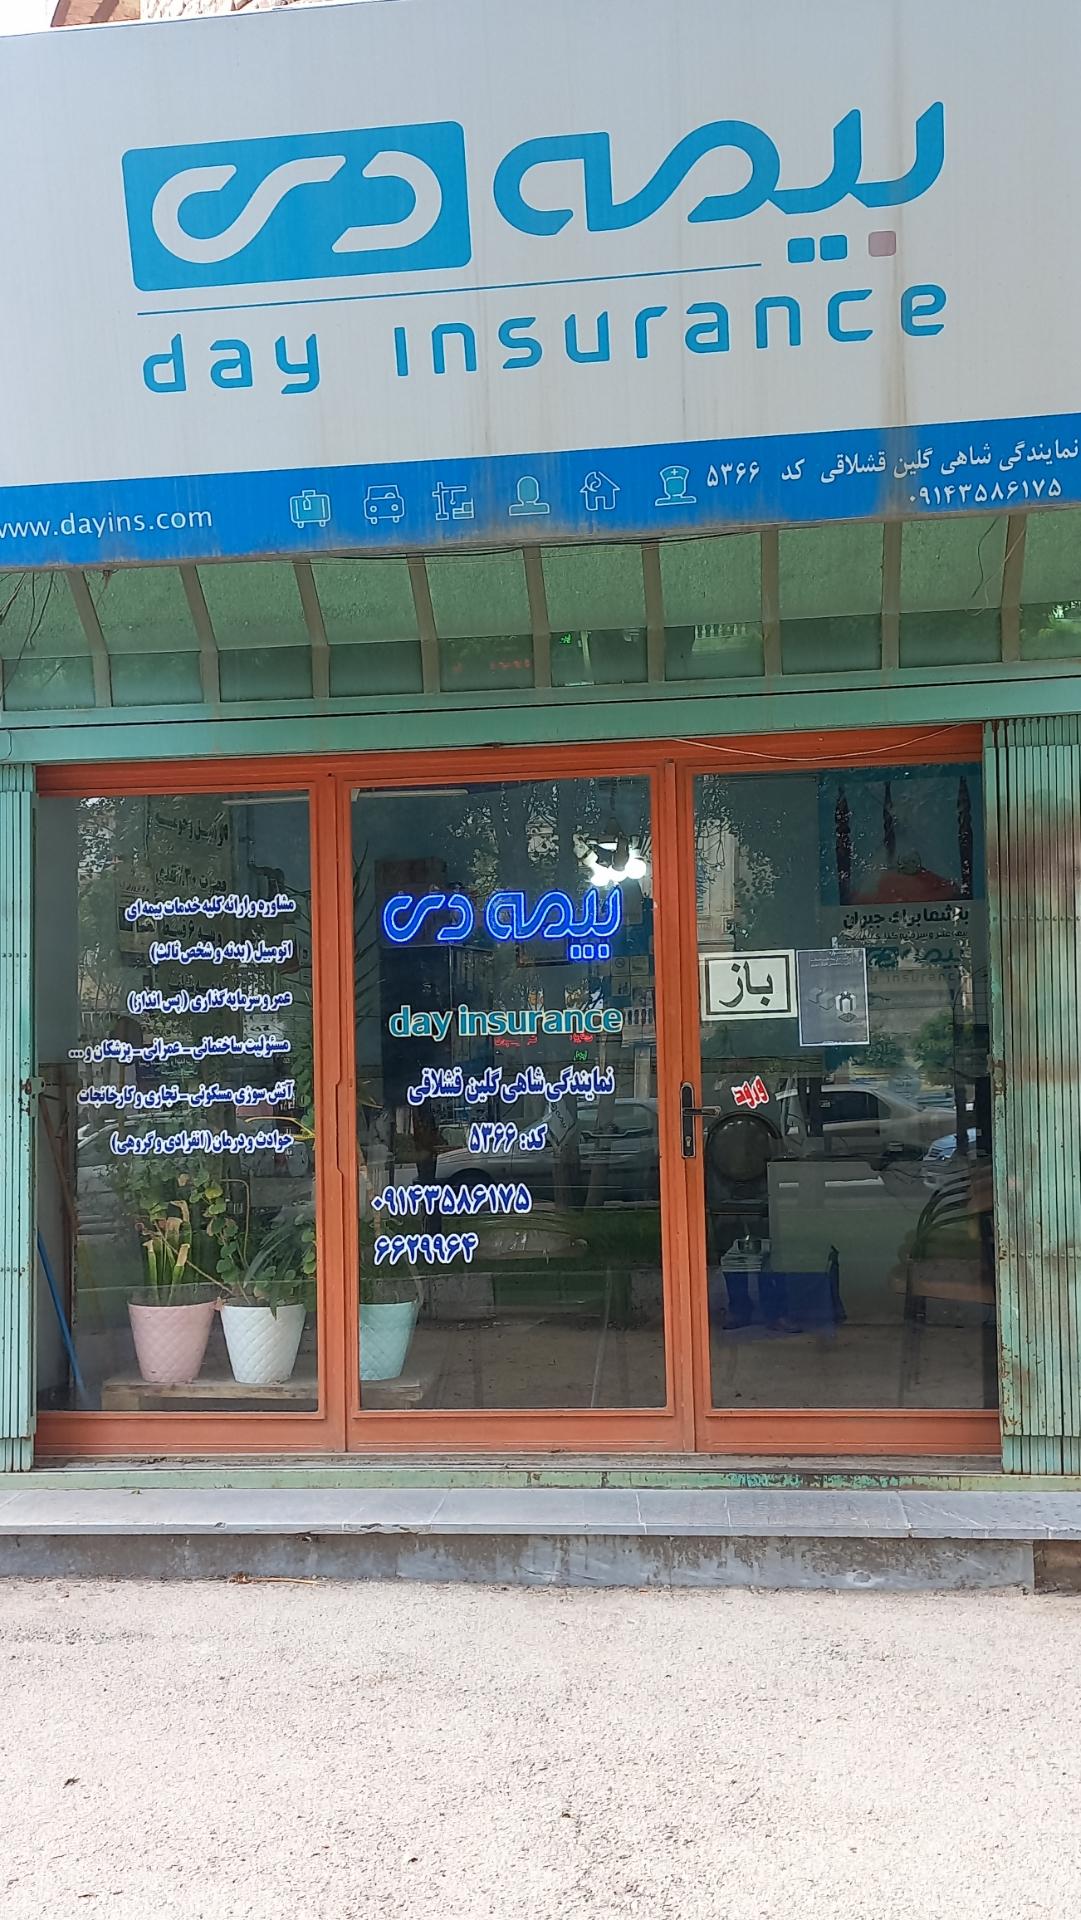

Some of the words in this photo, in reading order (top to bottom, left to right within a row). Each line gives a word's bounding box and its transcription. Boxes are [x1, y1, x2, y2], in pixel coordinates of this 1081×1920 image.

[493, 101, 945, 264] بیمه
[146, 144, 449, 269] دی
[143, 332, 321, 395] day
[394, 284, 947, 376] insurance
[820, 450, 886, 484] قشلاقی
[893, 447, 934, 479] گلین
[940, 443, 992, 476] شاهی
[999, 439, 1080, 471] نمایندگی
[707, 461, 760, 487] ۵۳۶۶
[781, 458, 806, 481] کد
[909, 477, 1062, 505] ۰۹۱۴۳۵۸۶۱۷۵
[125, 898, 142, 921] ای
[142, 901, 163, 920] بیمه
[164, 896, 202, 914] خدمات
[202, 895, 224, 918] کلیه
[224, 894, 249, 918] ارائه
[248, 900, 258, 917] و
[258, 894, 296, 917] مشاوره
[383, 893, 475, 942] دی
[486, 885, 623, 960] بیمه
[149, 940, 181, 964] ثالث)
[181, 940, 213, 964] شخص
[213, 947, 222, 964] و
[223, 940, 253, 963] (بدنه
[253, 940, 293, 963] اتومبیل
[718, 960, 774, 1008] باز
[127, 990, 162, 1014] انداز)
[190, 988, 228, 1013] گذاری
[227, 988, 261, 1011] سرمایه
[261, 994, 270, 1011] و
[270, 991, 293, 1011] عمر
[389, 1005, 452, 1042] day
[458, 1004, 623, 1036] insurance
[93, 1039, 133, 1063] پزشکان
[143, 1037, 182, 1060] عمرانی
[192, 1035, 244, 1059] ساختمانی
[245, 1034, 291, 1057] مسئولیت
[190, 1083, 233, 1107] مسکونی
[234, 1085, 267, 1106] سوزی
[267, 1079, 295, 1104] آتش
[407, 1067, 464, 1106] قشلاقی
[465, 1066, 502, 1103] گلین
[501, 1066, 545, 1103] شاهی
[545, 1065, 615, 1102] نمایندگی
[731, 1075, 769, 1109] ورود
[77, 1085, 136, 1109] کارخانجات
[134, 1092, 143, 1109] و
[144, 1085, 179, 1108] تجاری
[110, 1130, 156, 1155] گروهی)
[154, 1137, 163, 1154] و
[165, 1130, 212, 1154] (انفرادی
[212, 1130, 246, 1153] درمان
[245, 1135, 255, 1153] و
[255, 1129, 294, 1153] حوادث
[469, 1122, 518, 1153] ۵۳۶۶
[519, 1123, 548, 1151] کد:
[371, 1183, 532, 1216] ۰۹۱۴۳۵۸۶۱۷۵
[374, 1232, 479, 1265] ۶۶۲۹۹۶۴
